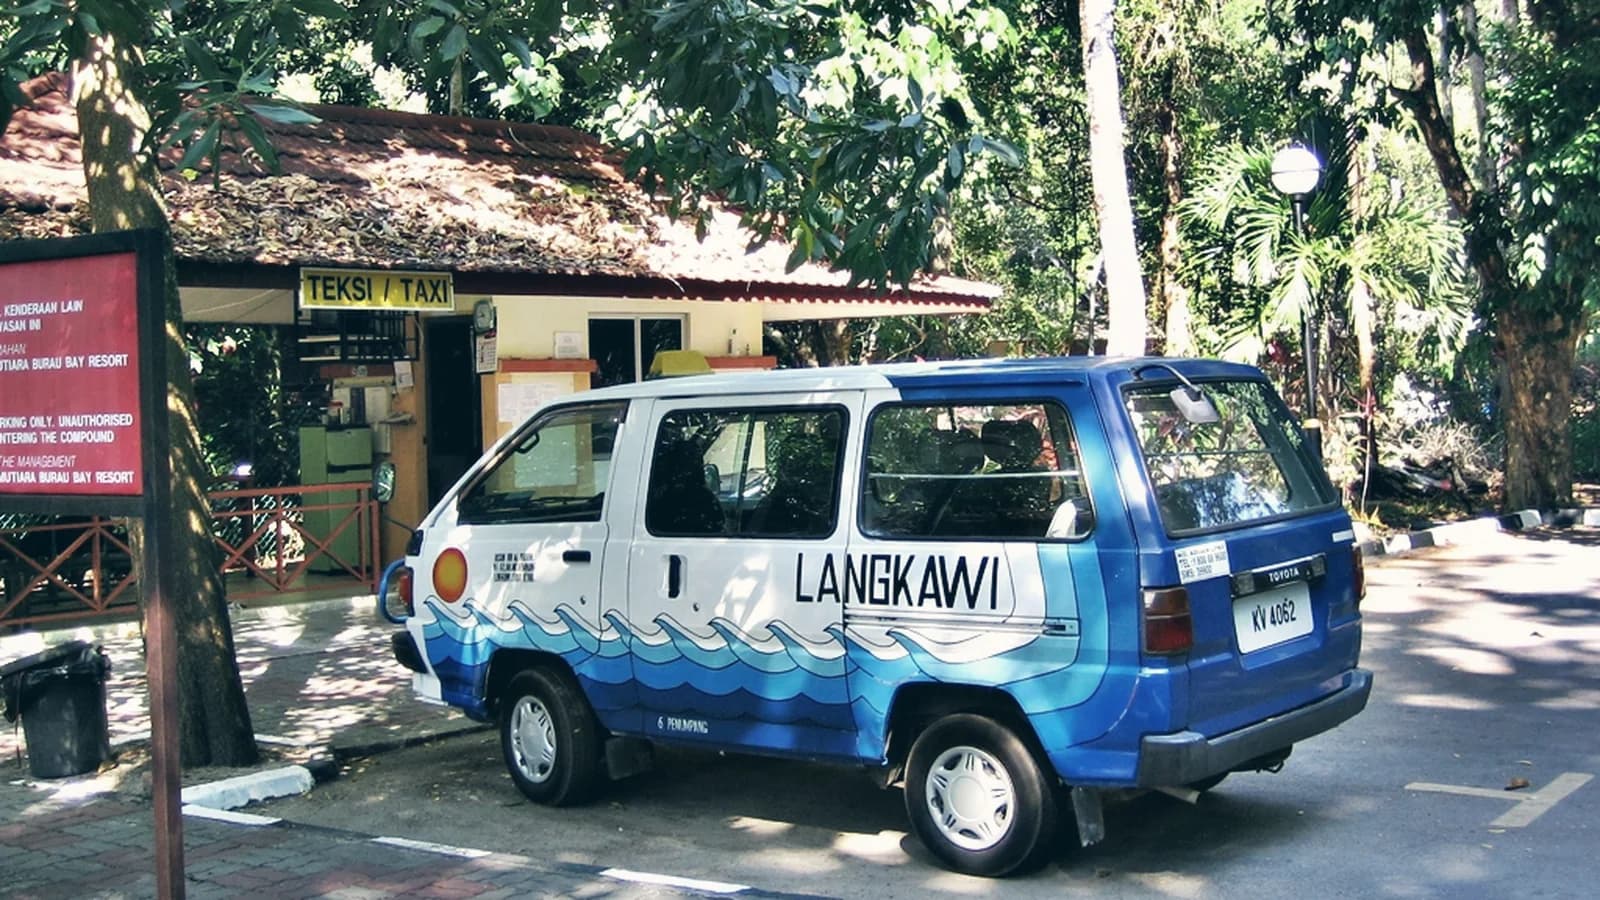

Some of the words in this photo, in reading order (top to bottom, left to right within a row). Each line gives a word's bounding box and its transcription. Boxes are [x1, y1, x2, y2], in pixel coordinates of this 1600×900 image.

[307, 275, 372, 301] TEKSI
[383, 278, 390, 300] /
[400, 278, 448, 303] TAXI
[4, 302, 57, 317] KENDERAAN
[61, 299, 84, 313] LAIN
[0, 320, 26, 333] ASAN
[29, 318, 41, 331] INI
[32, 357, 62, 370] BURAU
[65, 356, 85, 369] BAY
[88, 354, 128, 367] RESORT
[58, 413, 133, 427] UNAUTHORISED
[40, 431, 57, 444] THE
[60, 430, 115, 443] COMPOUND
[17, 454, 77, 468] MANAGEMENT
[39, 471, 69, 484] BURAU
[72, 471, 92, 484] BAY
[95, 471, 135, 483] RESORT
[795, 552, 1000, 611] LANGKAWI
[1268, 567, 1300, 583] TOYOTA
[1252, 604, 1267, 632] KV
[1270, 598, 1297, 626] 4062
[657, 716, 664, 729] 6
[667, 717, 709, 734] PENUMPANG
